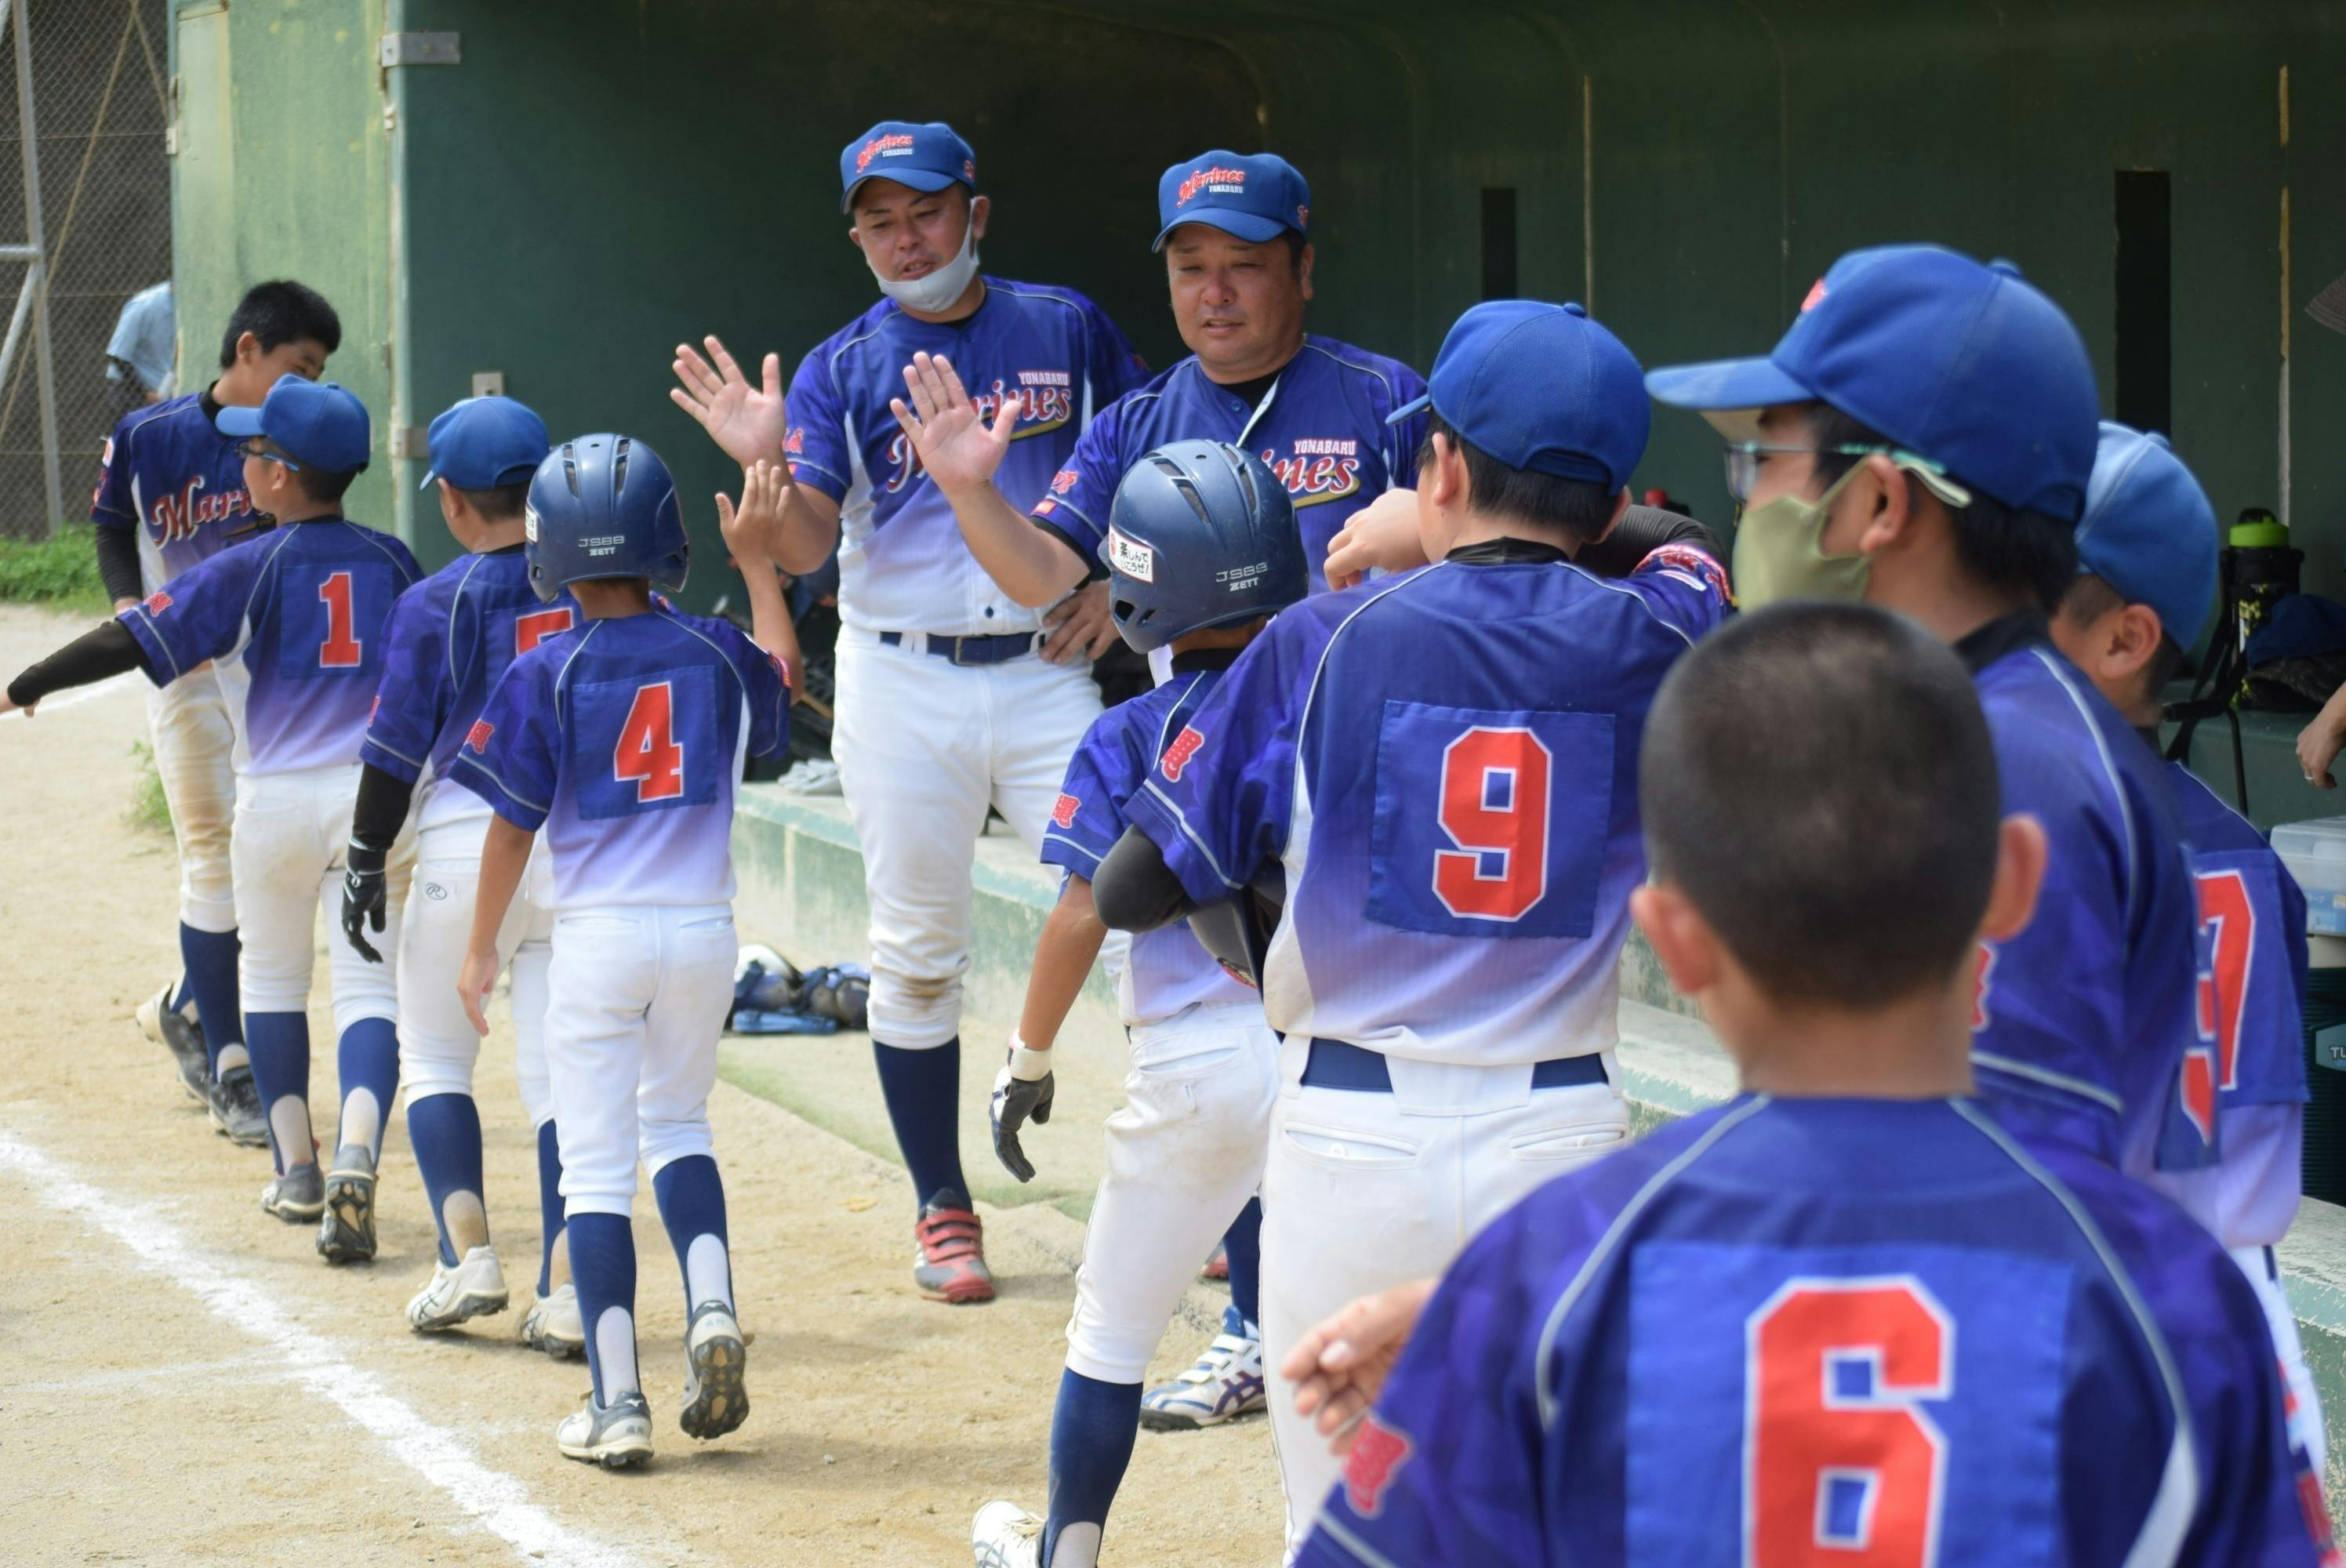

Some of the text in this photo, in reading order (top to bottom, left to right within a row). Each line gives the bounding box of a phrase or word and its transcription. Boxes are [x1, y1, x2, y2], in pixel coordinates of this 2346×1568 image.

[1176, 166, 1246, 209] Marines
[1018, 371, 1070, 386] YONABARU
[1295, 439, 1356, 456] YONABARU
[589, 546, 616, 557] ZETT
[1229, 577, 1259, 592] ZETT
[319, 571, 362, 668] 1
[613, 681, 684, 804] 4
[1431, 724, 1552, 923] 9
[1739, 1273, 1957, 1568] 6
